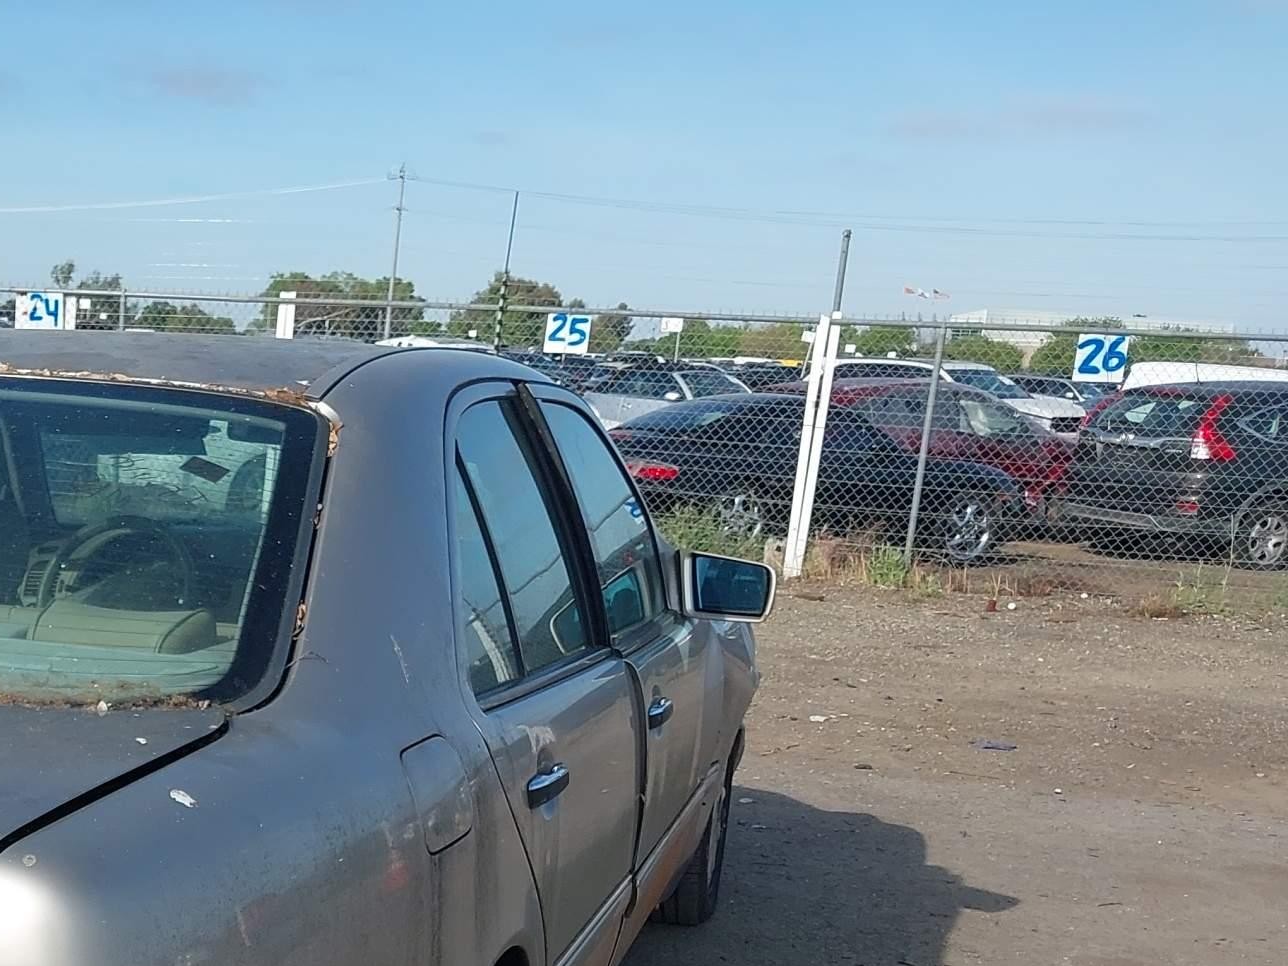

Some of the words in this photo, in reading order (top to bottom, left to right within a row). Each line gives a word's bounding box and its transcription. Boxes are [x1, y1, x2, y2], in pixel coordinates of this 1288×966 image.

[29, 293, 59, 327] 24
[548, 313, 589, 346] 25
[1078, 335, 1126, 374] 26
